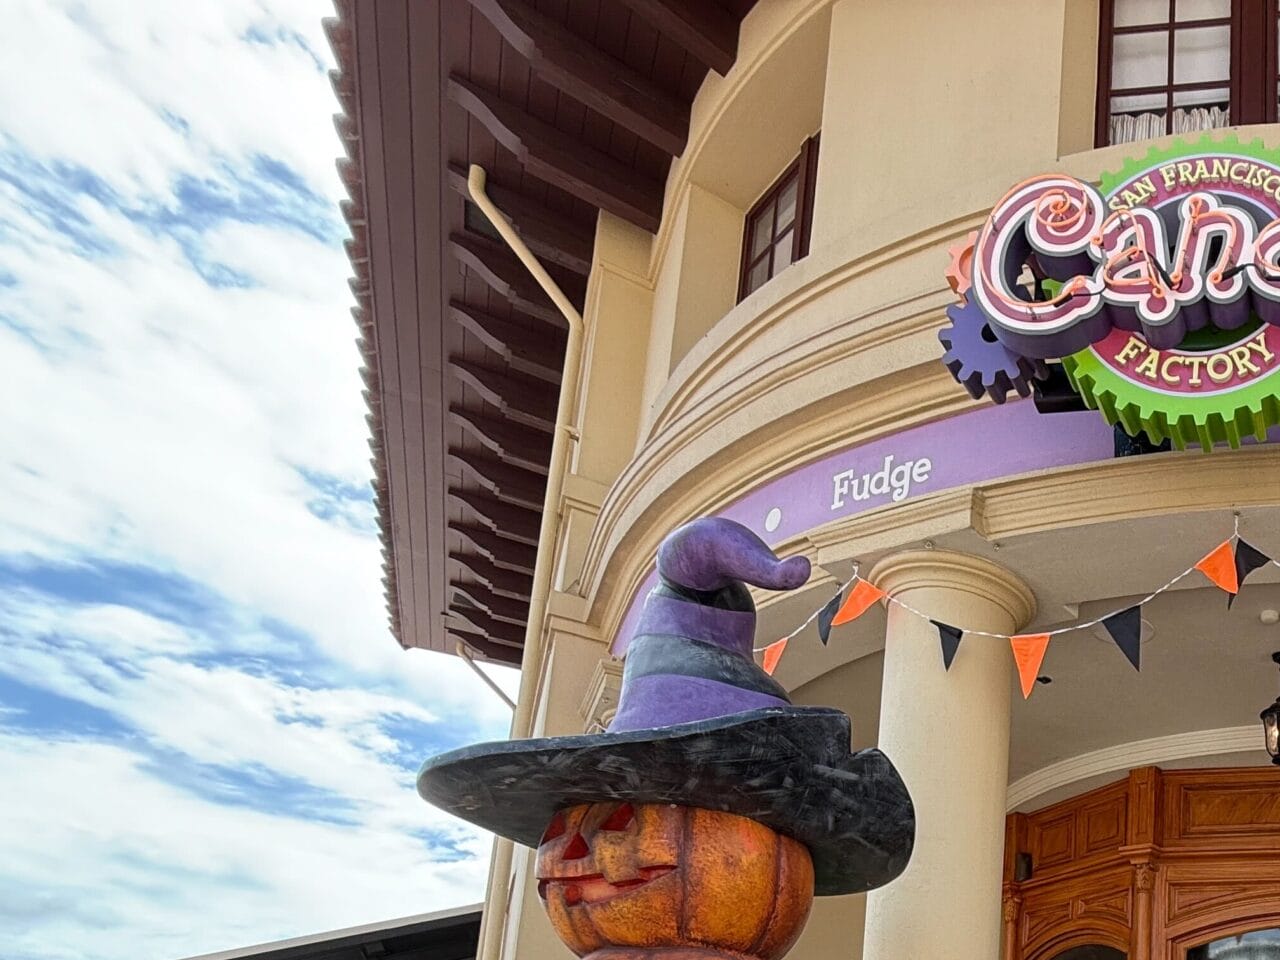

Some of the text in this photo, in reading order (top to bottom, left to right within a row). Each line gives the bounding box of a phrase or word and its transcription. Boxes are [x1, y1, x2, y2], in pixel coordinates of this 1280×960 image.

[1108, 175, 1157, 211] SAN
[1114, 332, 1275, 386] FACTORY
[831, 455, 932, 510] Fudge
